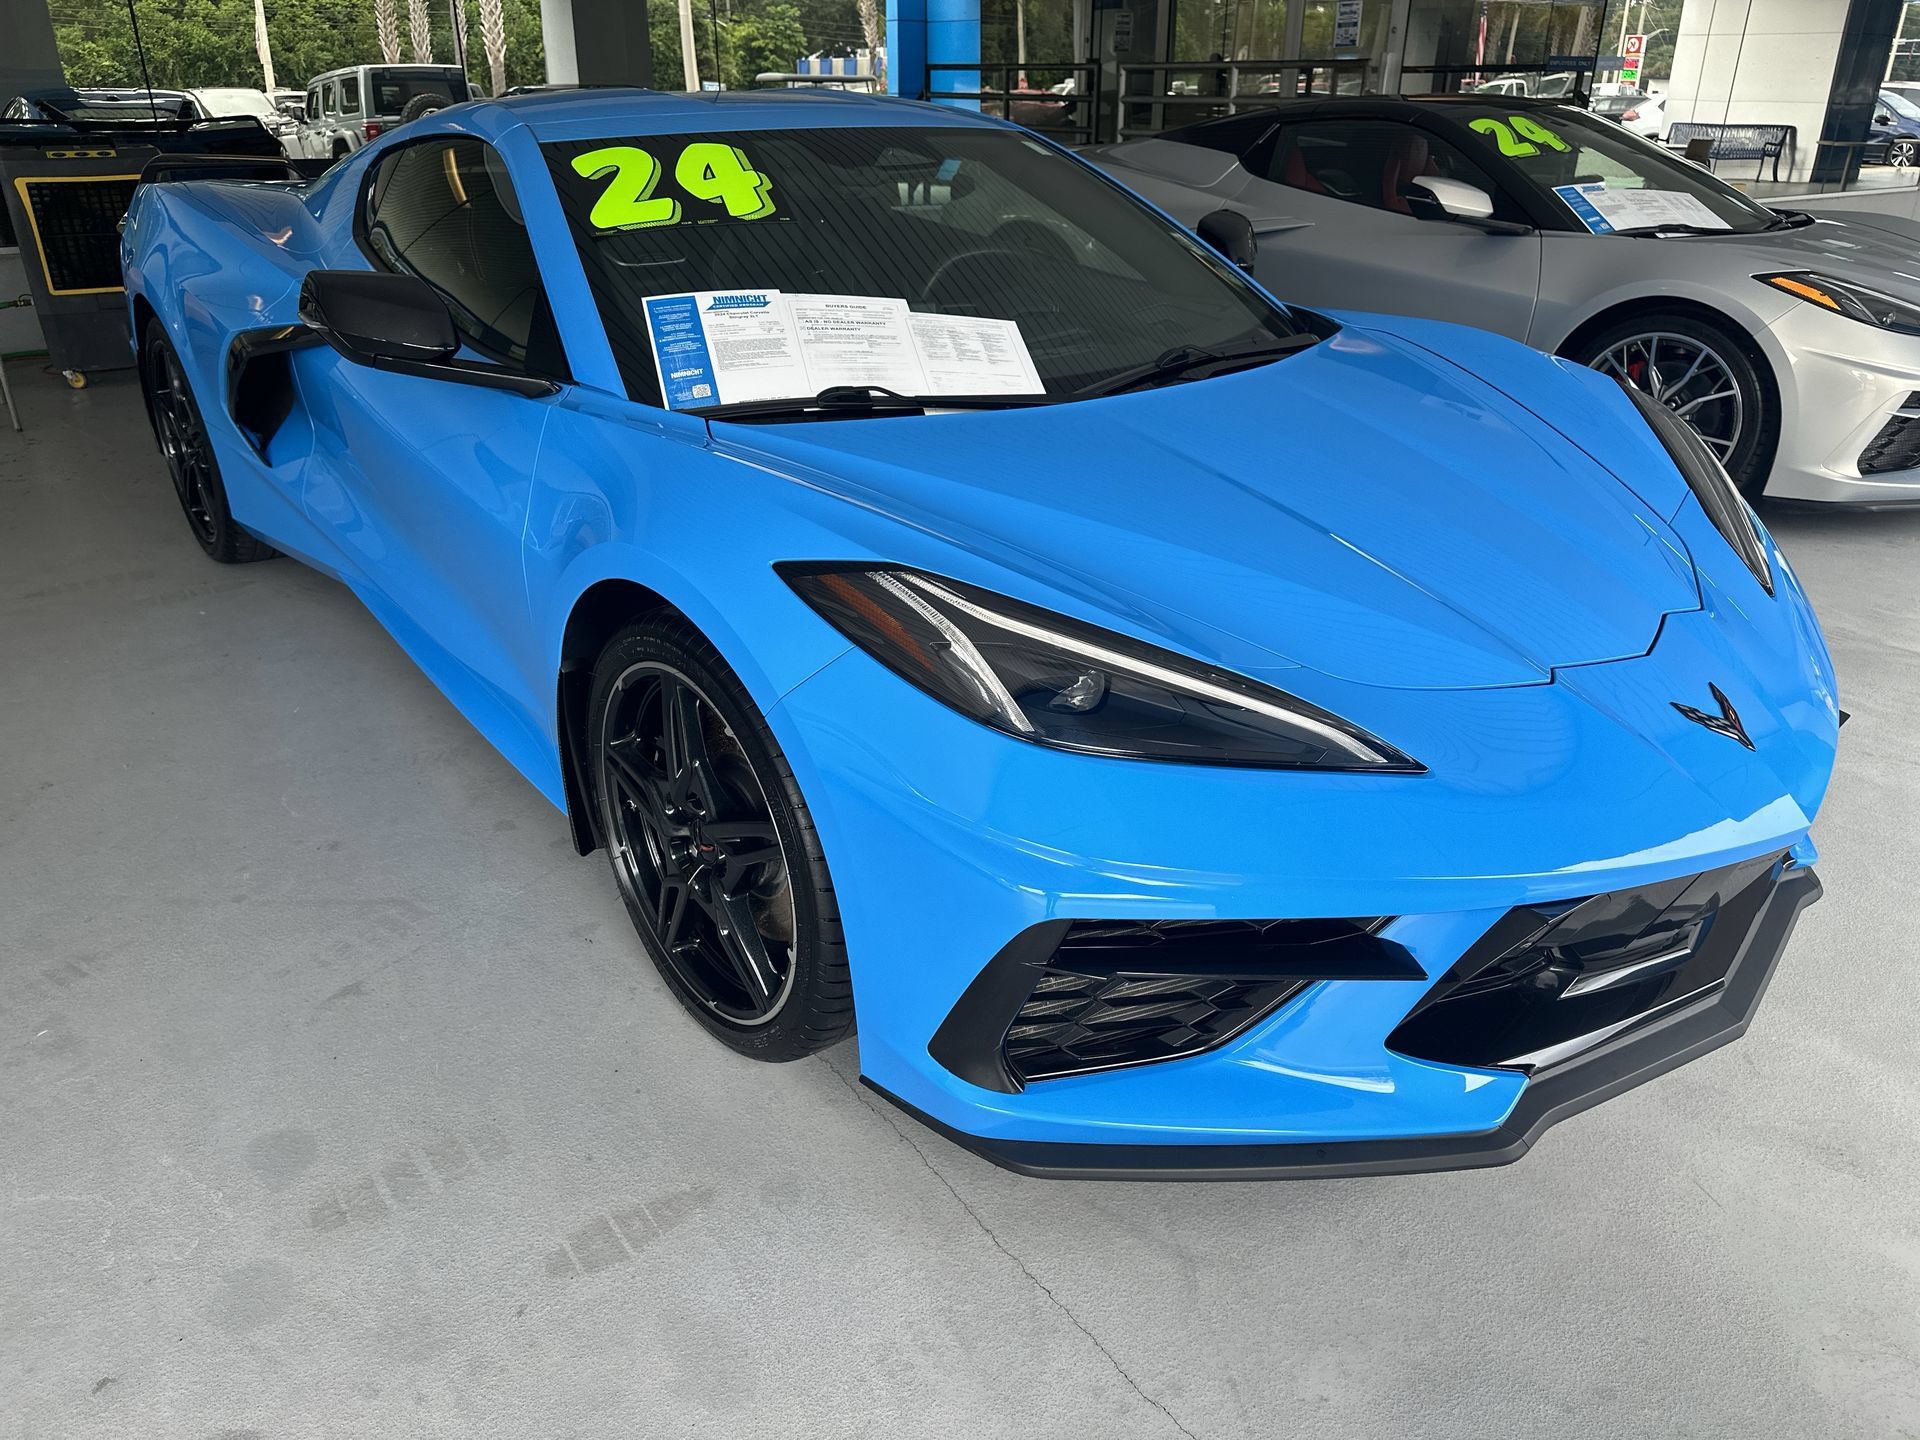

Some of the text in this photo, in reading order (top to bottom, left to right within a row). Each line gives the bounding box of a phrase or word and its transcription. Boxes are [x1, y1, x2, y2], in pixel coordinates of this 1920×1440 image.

[1468, 116, 1572, 158] 24
[571, 142, 776, 231] 24
[712, 294, 767, 303] NIMNICHT
[670, 368, 704, 379] NIMNICHT
